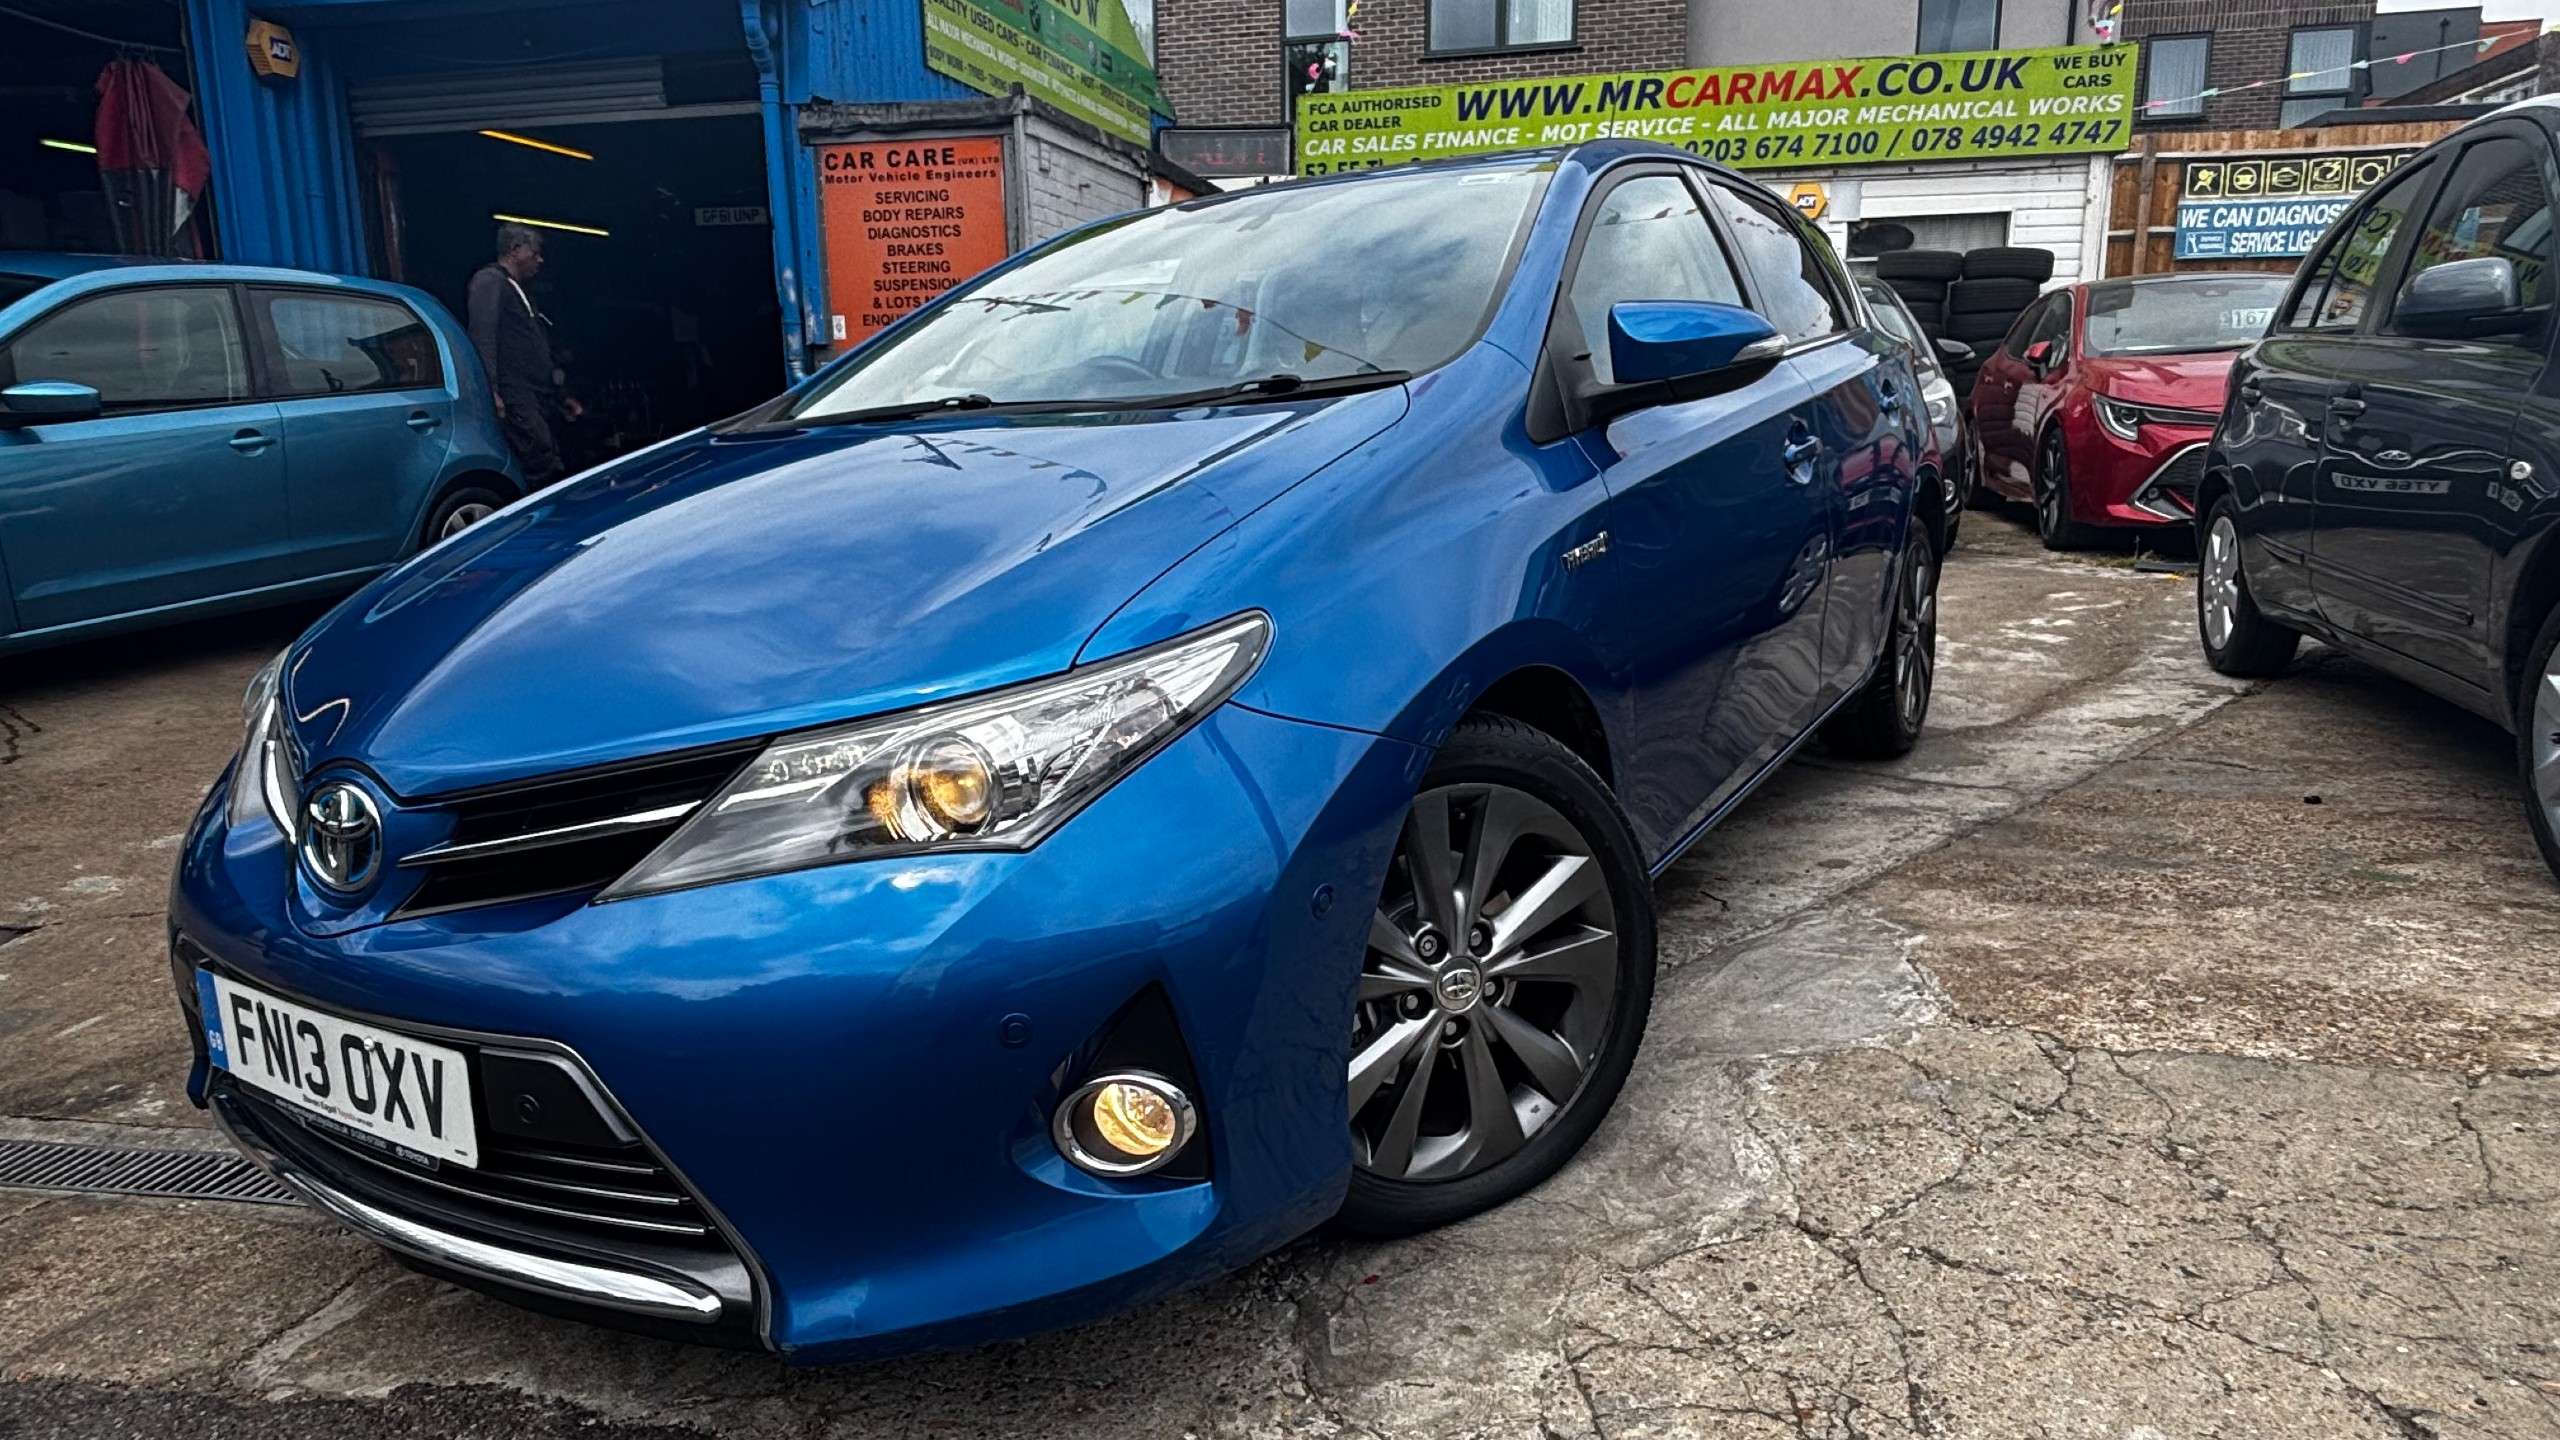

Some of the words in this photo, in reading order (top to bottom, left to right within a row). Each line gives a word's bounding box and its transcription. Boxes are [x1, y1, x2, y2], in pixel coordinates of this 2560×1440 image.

[970, 7, 995, 33] USED
[996, 23, 1019, 47] CARS
[1026, 39, 1042, 60] CAR
[2053, 56, 2082, 70] WE
[2088, 52, 2127, 69] BUY
[1457, 56, 2034, 121] WWW.MRCARMAX.CO.UK
[2063, 73, 2112, 89] CARS
[1309, 103, 1337, 115] FCA
[1341, 95, 1442, 114] AUTHORISED
[1304, 138, 1346, 156] CAR
[1351, 134, 1417, 154] SALES
[1423, 127, 1521, 149] FINANCE
[1541, 122, 1592, 142] MOT
[1596, 116, 1697, 139] SERVICE
[1716, 112, 1759, 132] ALL
[1766, 107, 1849, 129] MAJOR
[1856, 98, 2019, 125] MECHANICAL
[2028, 93, 2124, 117] WORKS
[1309, 120, 1339, 133] CAR
[1344, 116, 1402, 131] DEALER
[1755, 134, 1805, 159] 674
[1812, 130, 1880, 157] 7100
[1885, 128, 1904, 157] /
[1911, 126, 1963, 152] 078
[1970, 122, 2042, 149] 4942
[2048, 119, 2122, 145] 4747
[824, 151, 874, 171] CAR
[886, 147, 955, 168] CARE
[825, 173, 863, 184] Motor
[869, 171, 920, 183] Vehicle
[926, 169, 997, 182] Engineers
[875, 189, 950, 205] SERVICING
[863, 209, 901, 223] BODY
[905, 206, 965, 221] REPAIRS
[2181, 208, 2210, 229] WE
[2213, 206, 2251, 228] CAN
[868, 224, 962, 240] DIAGNOSTICS
[887, 242, 944, 257] BRAKES
[2229, 231, 2286, 254] SERVICE
[882, 260, 951, 275] STEERING
[873, 278, 962, 292] SUSPENSION
[873, 297, 882, 309] &
[886, 296, 920, 309] LOTS
[863, 314, 904, 327] ENQU
[209, 1029, 224, 1052] GB
[229, 992, 331, 1099] FN13
[340, 1034, 444, 1139] OXV
